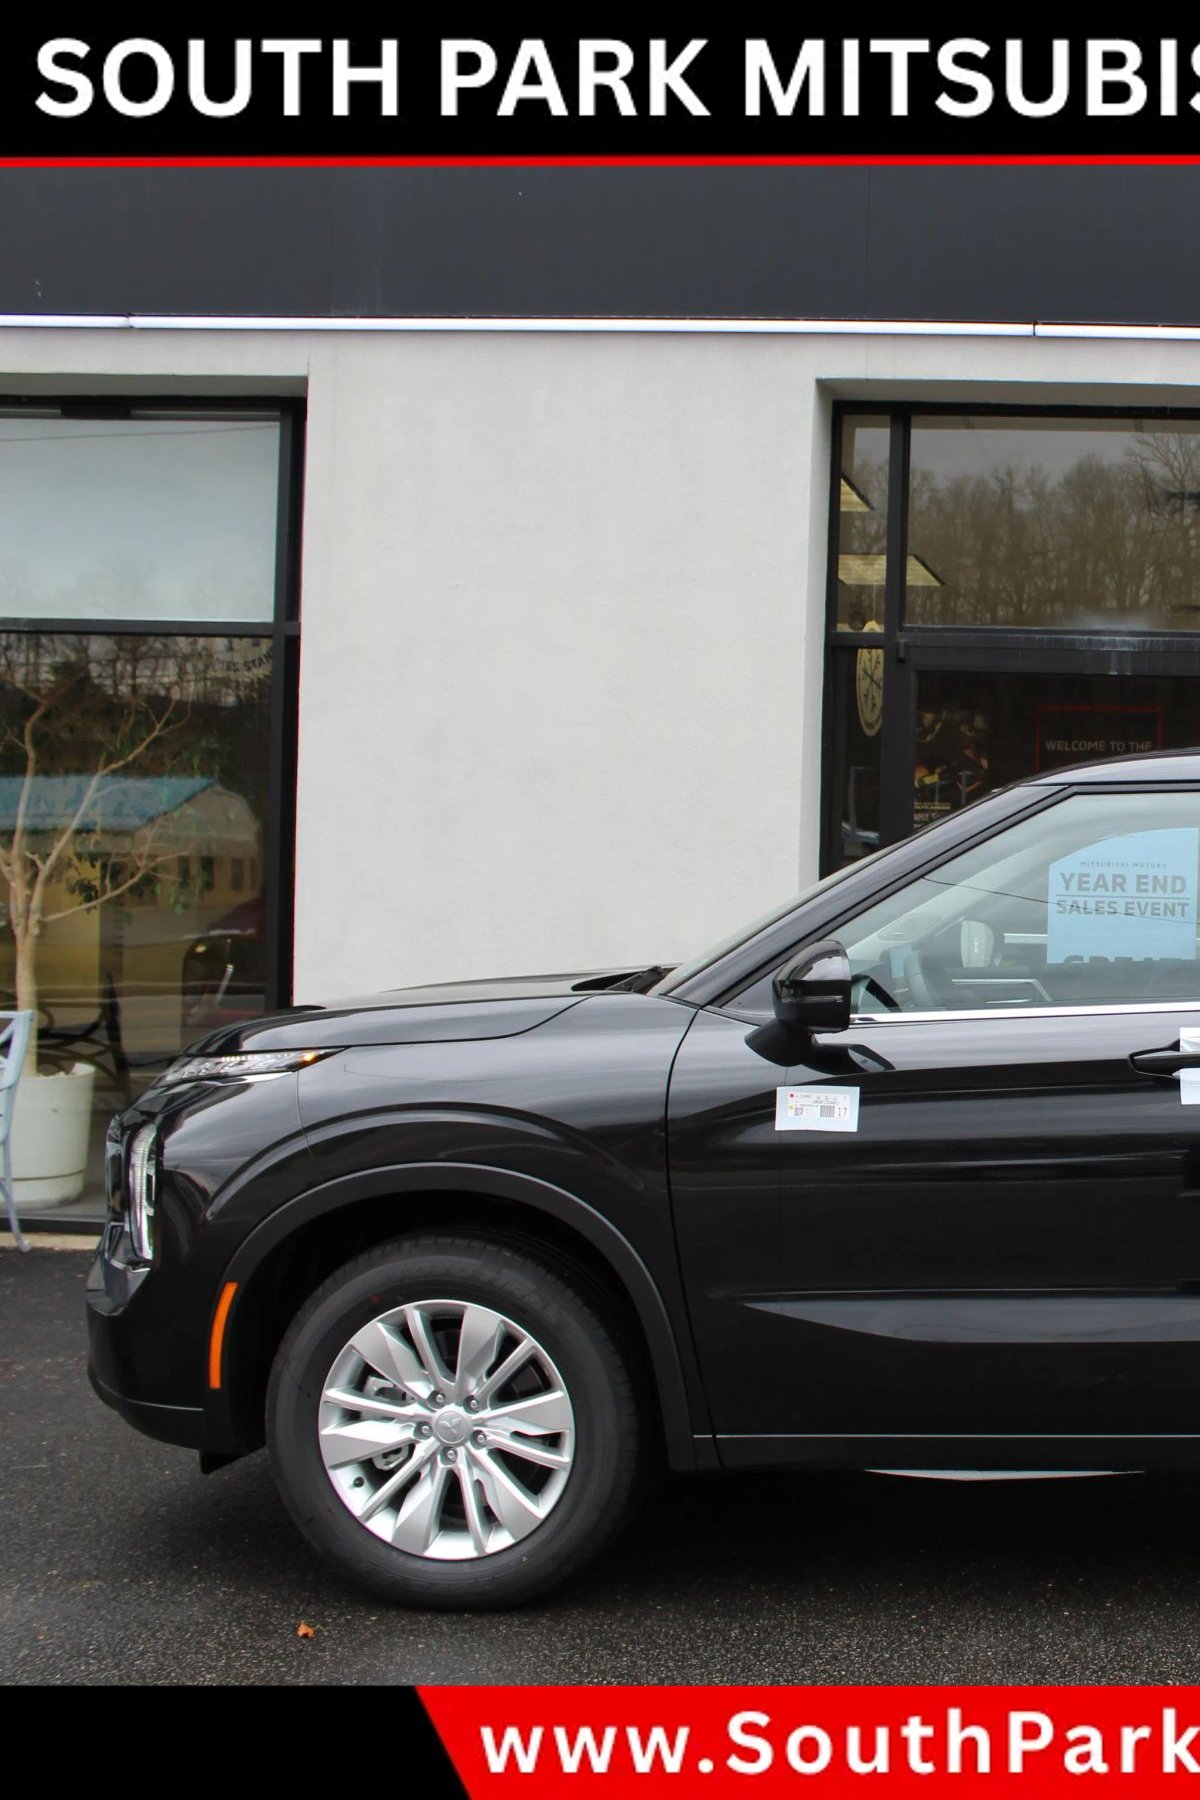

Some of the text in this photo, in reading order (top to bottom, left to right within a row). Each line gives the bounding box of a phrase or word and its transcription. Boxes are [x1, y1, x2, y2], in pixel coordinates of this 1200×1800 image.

[1045, 740, 1105, 751] WELCOME
[1109, 741, 1125, 752] TO
[1059, 872, 1186, 894] YEAR END
[1056, 900, 1189, 918] SALES EVENT
